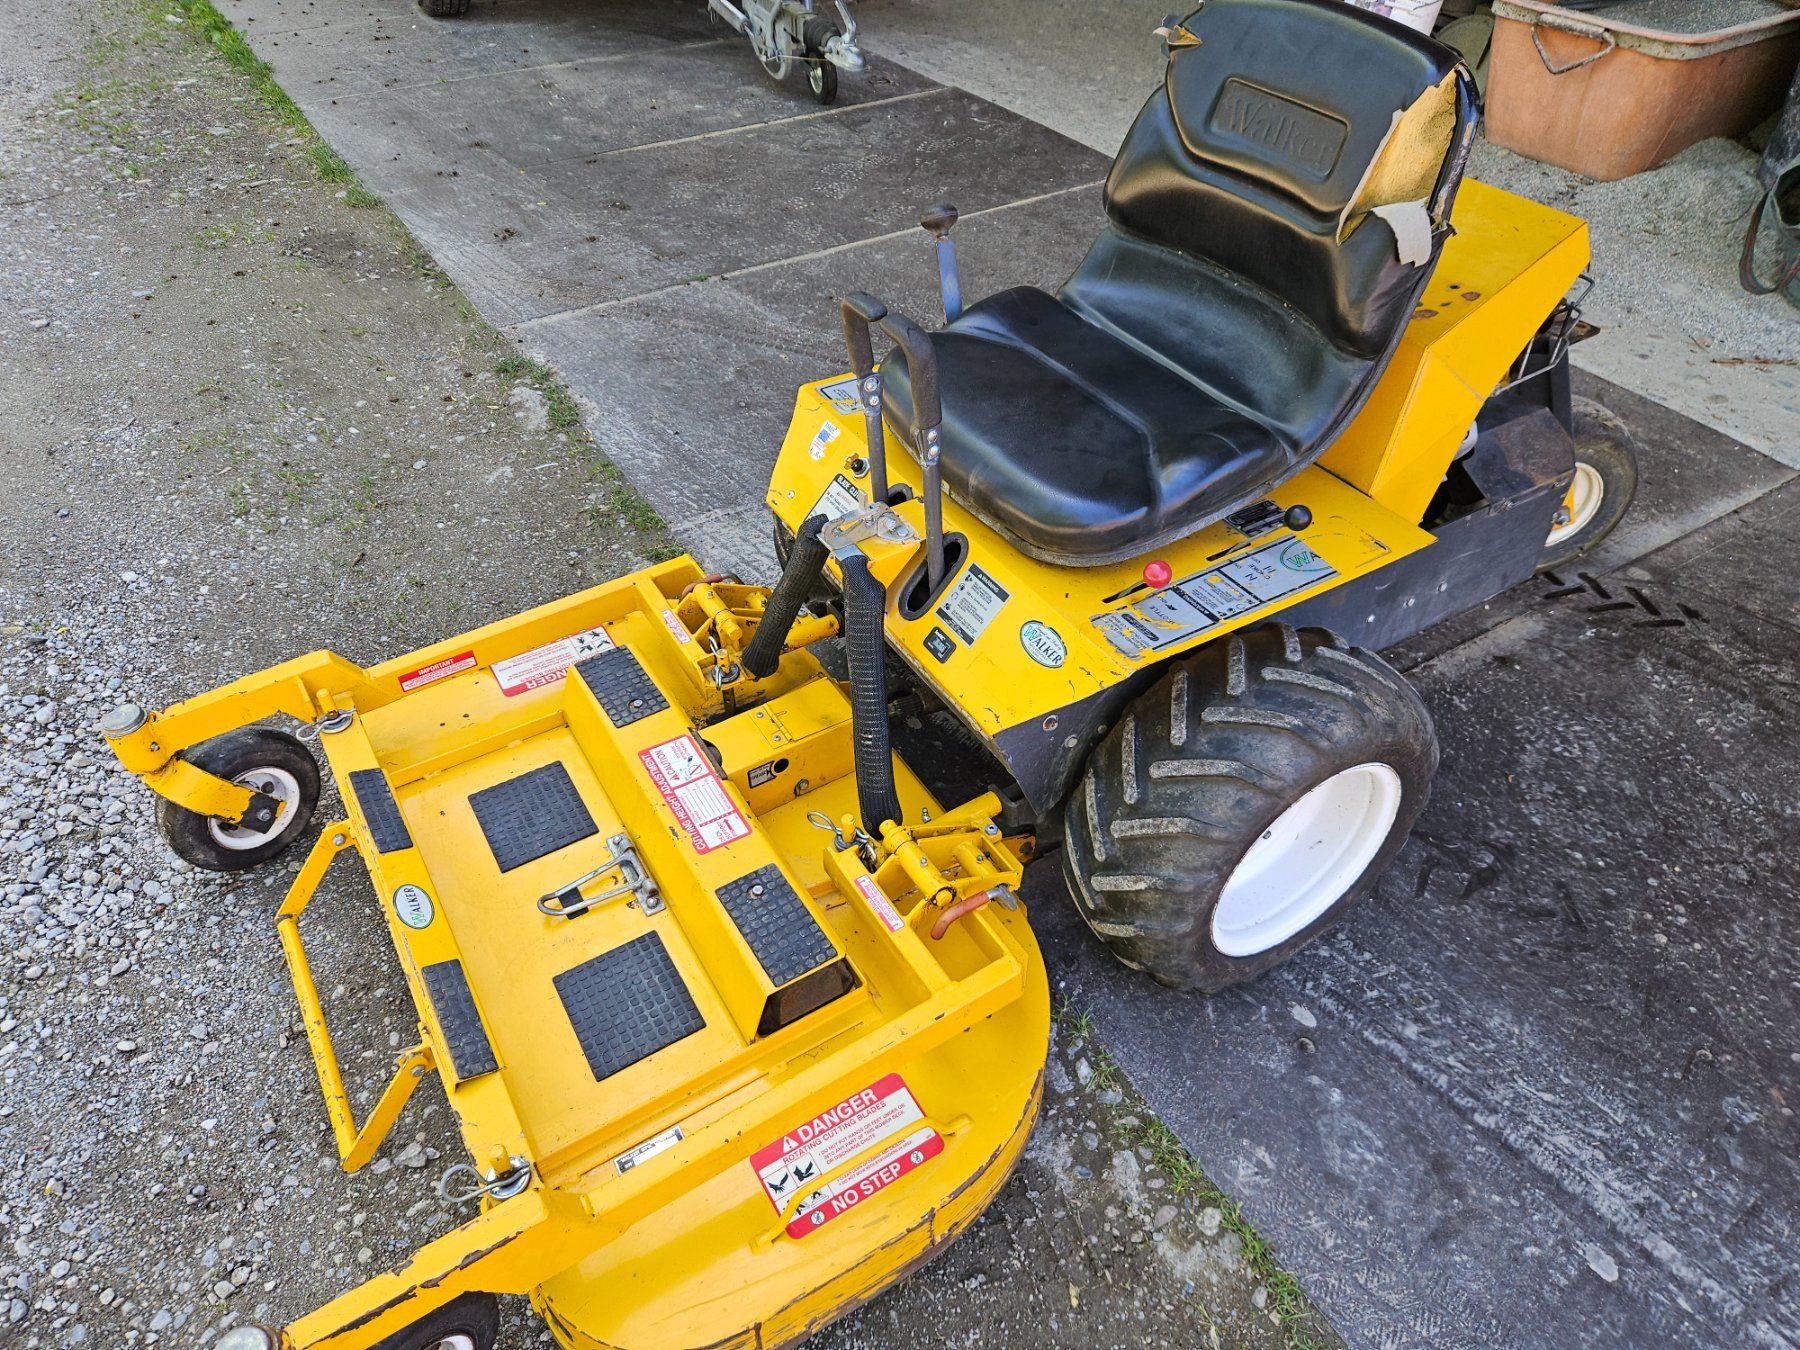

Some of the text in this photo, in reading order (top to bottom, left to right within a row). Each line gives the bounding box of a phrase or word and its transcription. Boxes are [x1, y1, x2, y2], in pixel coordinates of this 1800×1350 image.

[1224, 95, 1334, 167] Walker
[1023, 624, 1062, 664] WALKER
[417, 658, 453, 675] IMPORTANT
[524, 667, 570, 689] NGER
[641, 753, 672, 795] ADJUSTMENT
[653, 749, 676, 775] CAUTION
[666, 794, 687, 820] HEIGHT
[681, 819, 706, 850] CUTTING
[403, 886, 426, 928] WALKER
[782, 1100, 887, 1164] ROTATING CUTTING BLADES
[796, 1087, 878, 1142] DANGER
[830, 1160, 903, 1212] NO STEP
